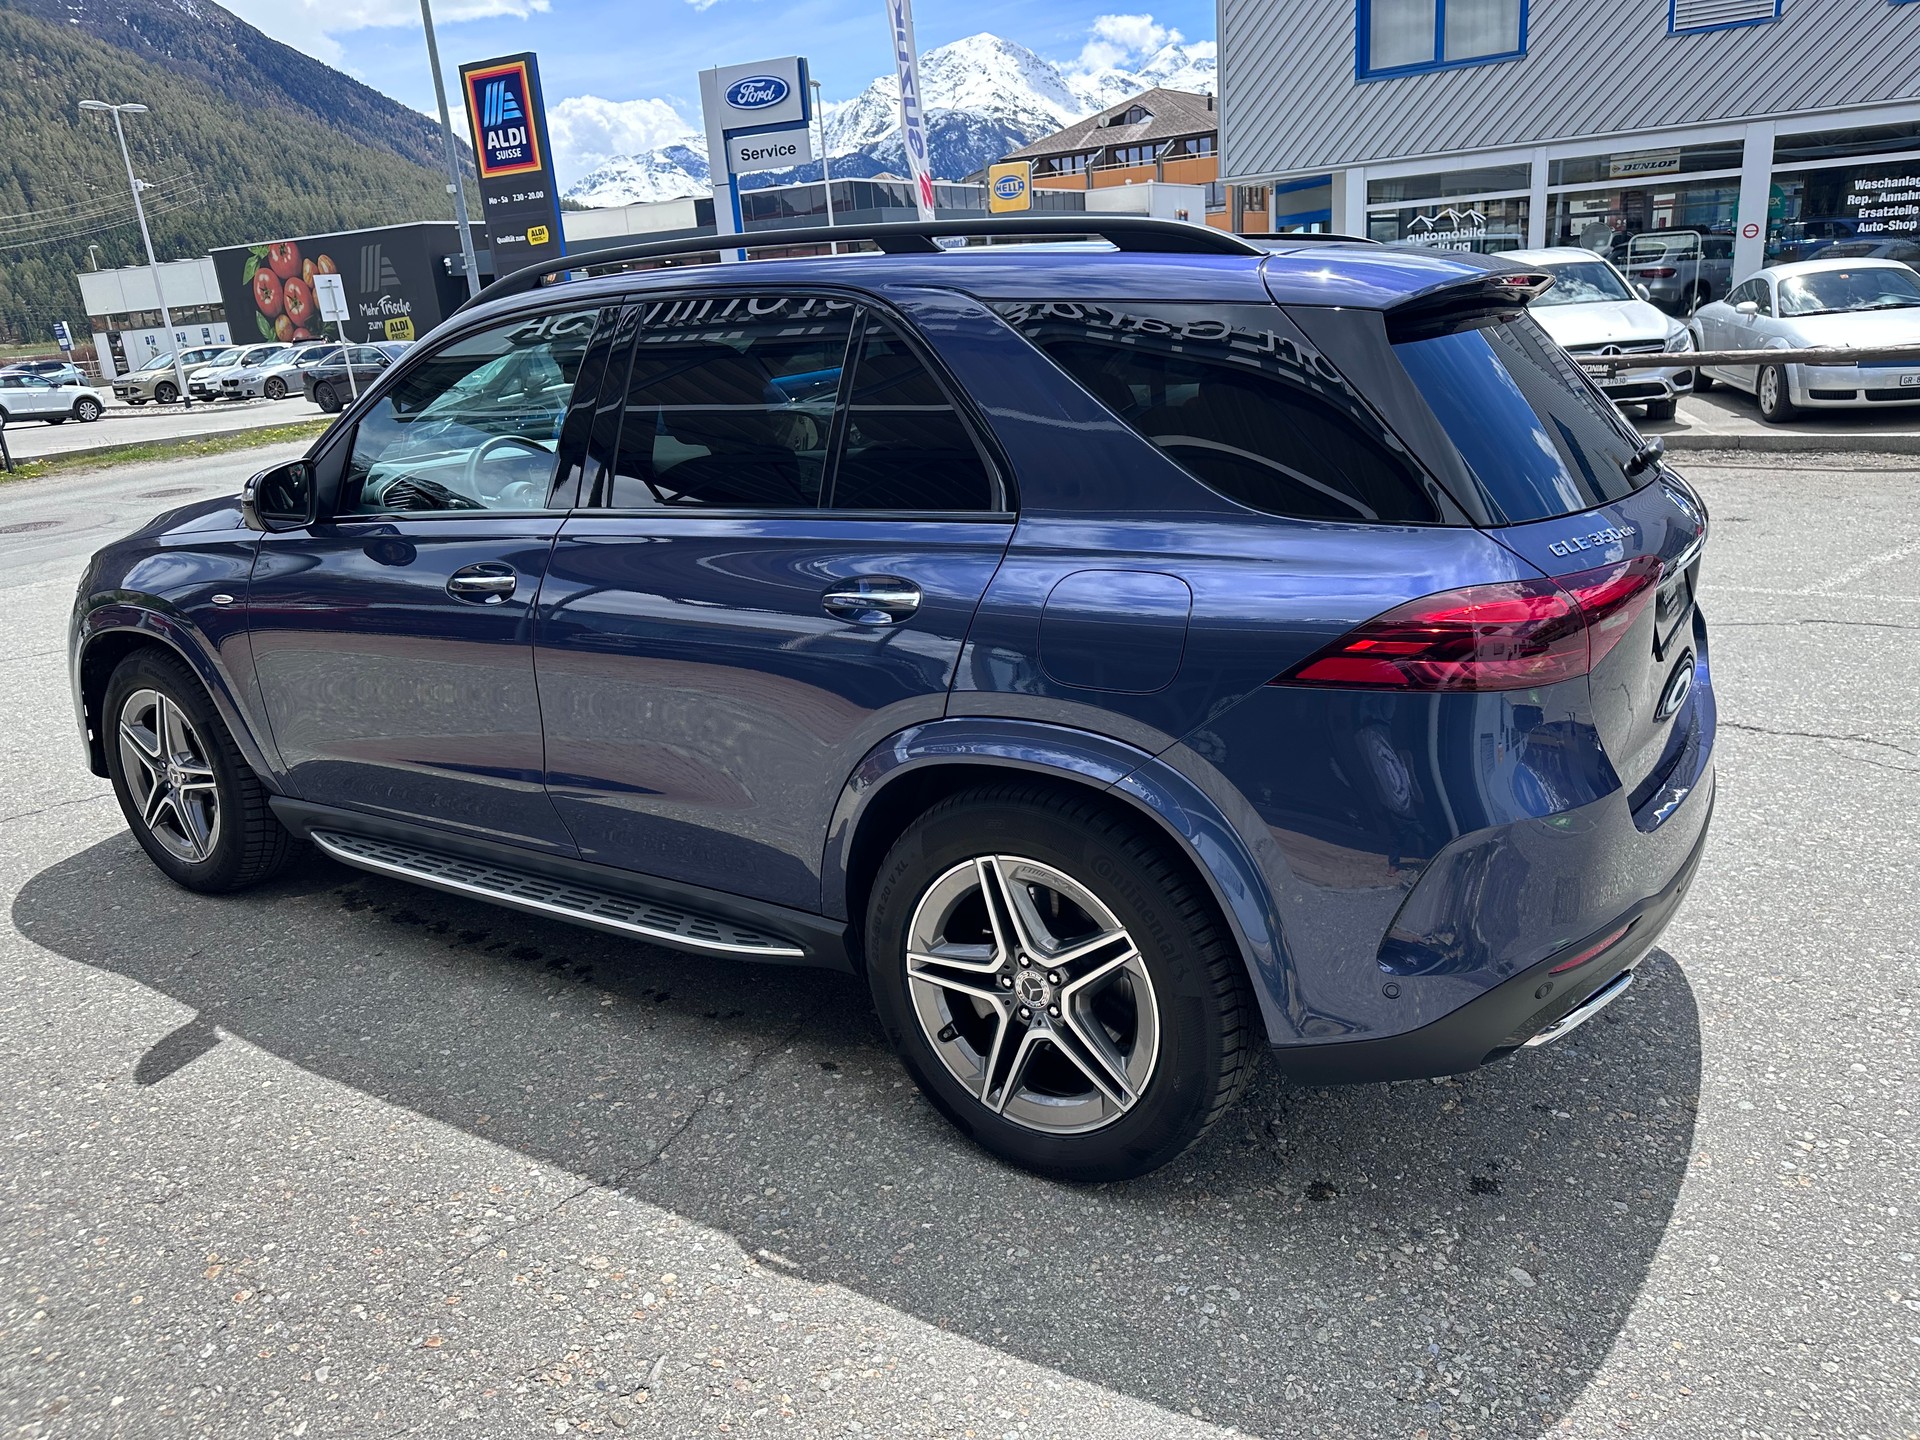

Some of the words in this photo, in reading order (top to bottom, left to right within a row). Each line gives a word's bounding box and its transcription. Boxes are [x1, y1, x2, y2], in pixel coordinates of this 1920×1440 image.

[737, 81, 776, 104] Ford
[487, 126, 527, 150] ALDI
[496, 148, 522, 160] SUISSE
[741, 144, 797, 161] Service
[1622, 159, 1678, 172] DUNLOP
[996, 181, 1025, 192] HELLA
[1847, 194, 1872, 206] Rep.
[1858, 204, 1919, 219] Ersatzteile
[531, 228, 545, 237] ALDI
[1857, 219, 1918, 233] Auto-Shop
[1406, 227, 1487, 243] automobile
[359, 303, 379, 316] Mehr
[377, 295, 411, 316] Frische
[368, 321, 383, 330] zum
[389, 319, 409, 333] ALDI
[1903, 376, 1913, 385] GR
[1548, 536, 1592, 557] GLE
[1089, 855, 1185, 963] Continental
